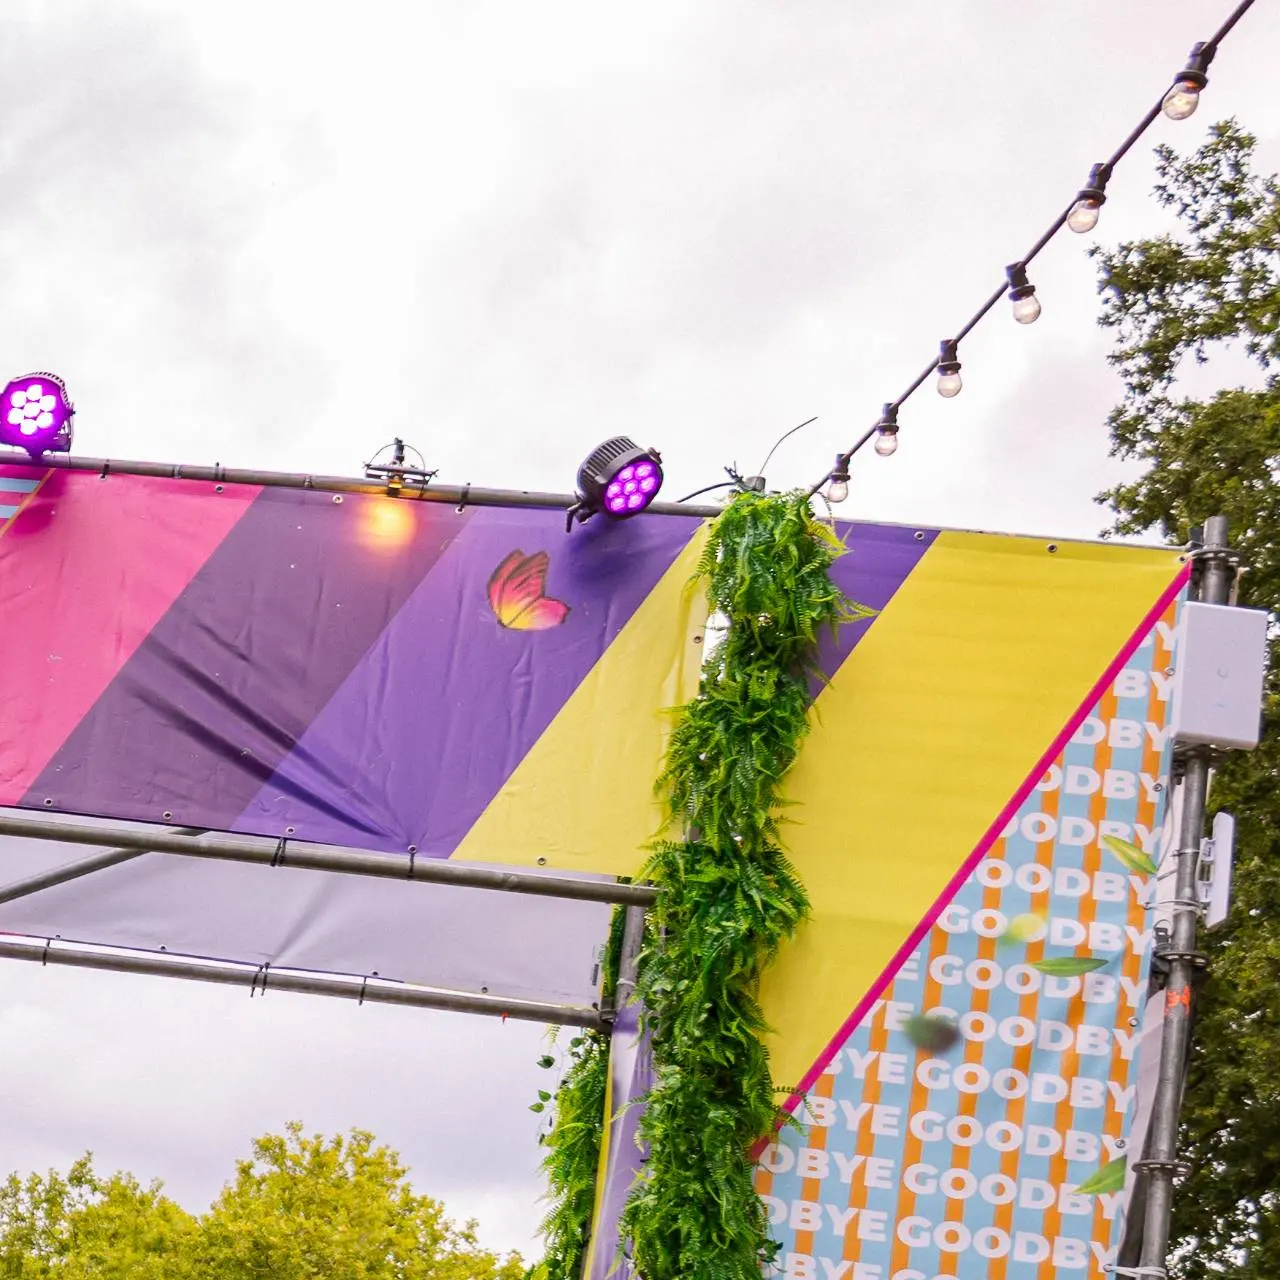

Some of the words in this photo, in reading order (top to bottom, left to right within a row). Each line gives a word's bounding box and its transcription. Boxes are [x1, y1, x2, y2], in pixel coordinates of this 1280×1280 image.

[916, 1059, 1137, 1113] GOODBY
[909, 1111, 1131, 1163] GOODBY
[897, 1216, 1119, 1273] GOODBY
